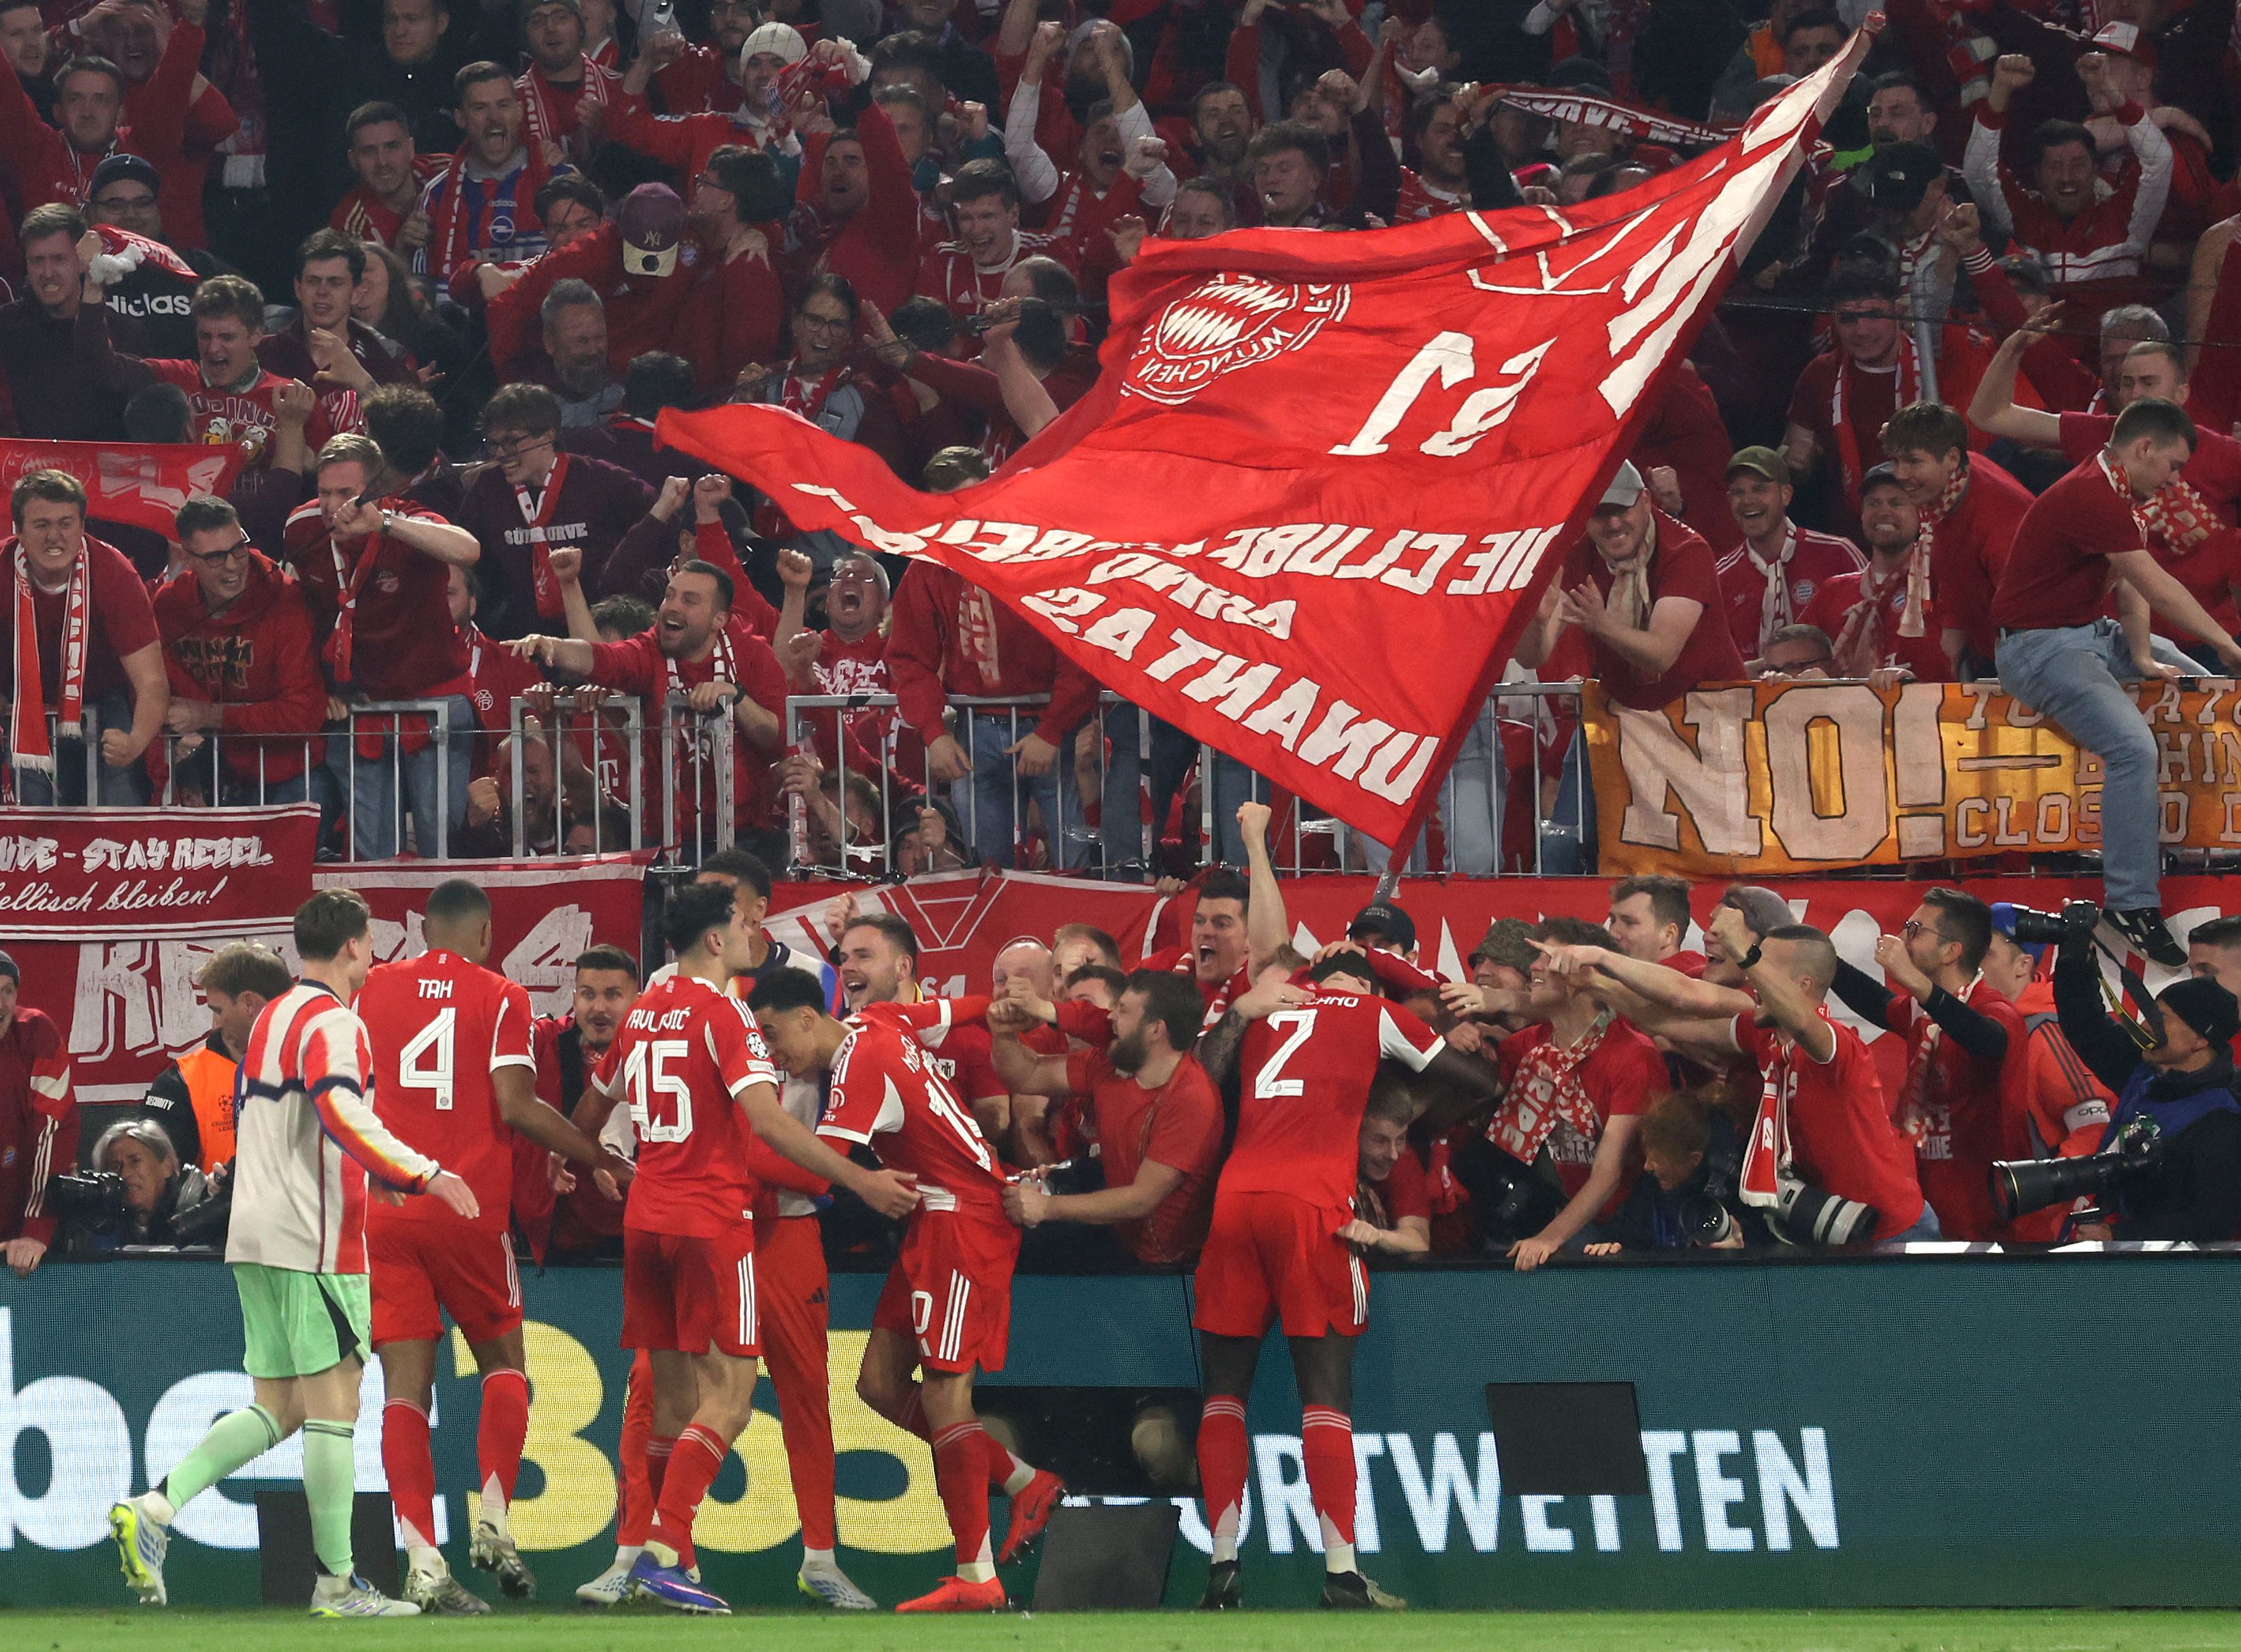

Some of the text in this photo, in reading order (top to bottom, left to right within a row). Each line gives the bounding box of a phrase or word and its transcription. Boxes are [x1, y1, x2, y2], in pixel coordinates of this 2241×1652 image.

[105, 293, 191, 317] didas
[504, 523, 588, 545] SÜURVE
[1607, 683, 1946, 860] NO!
[1956, 791, 2189, 848] CLOSD
[82, 837, 171, 874] STAY
[171, 836, 274, 871] REBEL
[0, 876, 229, 912] ellisch bleiben!
[418, 979, 454, 999] TAH
[399, 1008, 456, 1110] 4
[1255, 1009, 1318, 1099] 2
[146, 1095, 174, 1111] SECURITY
[2078, 1105, 2108, 1116] opp
